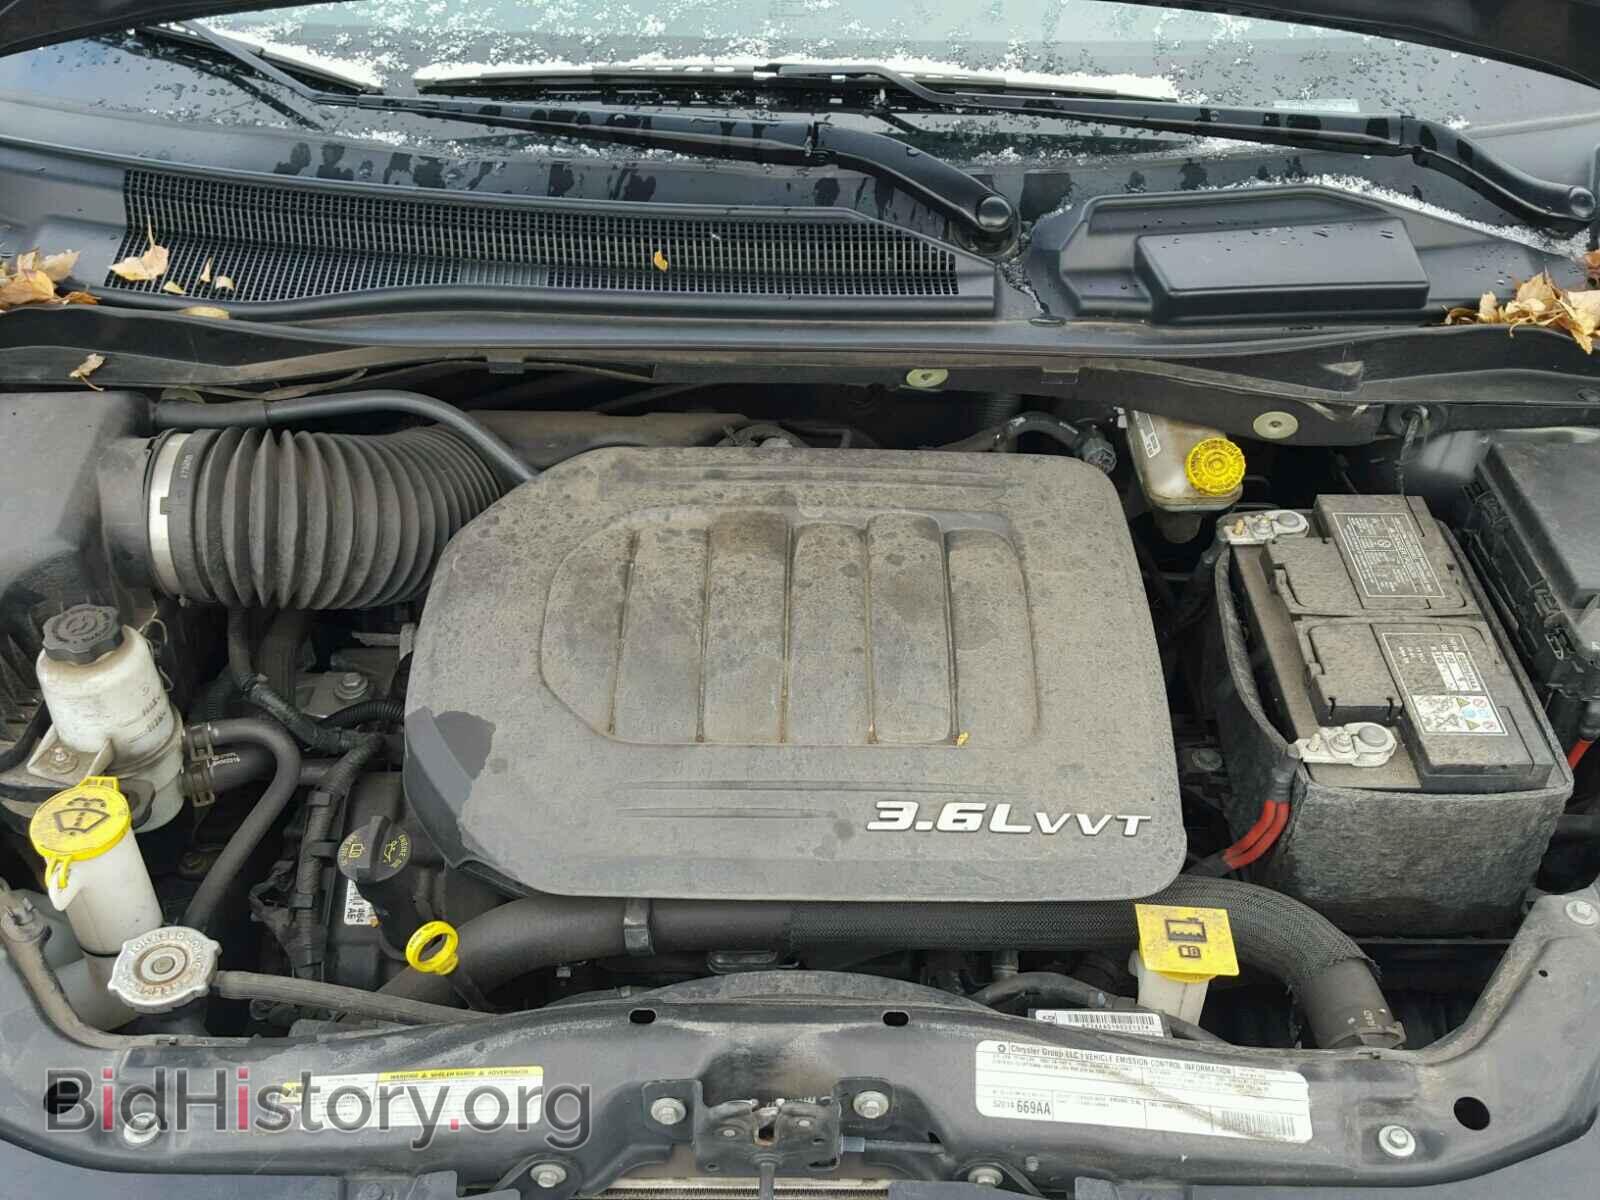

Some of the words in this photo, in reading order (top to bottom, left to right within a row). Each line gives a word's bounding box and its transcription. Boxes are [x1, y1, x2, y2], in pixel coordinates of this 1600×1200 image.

[1011, 1045, 1041, 1056] Chrysler
[1042, 1047, 1064, 1059] Group
[1085, 1052, 1112, 1063] VEHICLE
[1115, 1056, 1149, 1067] EMISSION
[1150, 1059, 1181, 1070] CONTROL
[1184, 1062, 1232, 1075] INFORMATION
[1016, 1099, 1052, 1116] 669AA
